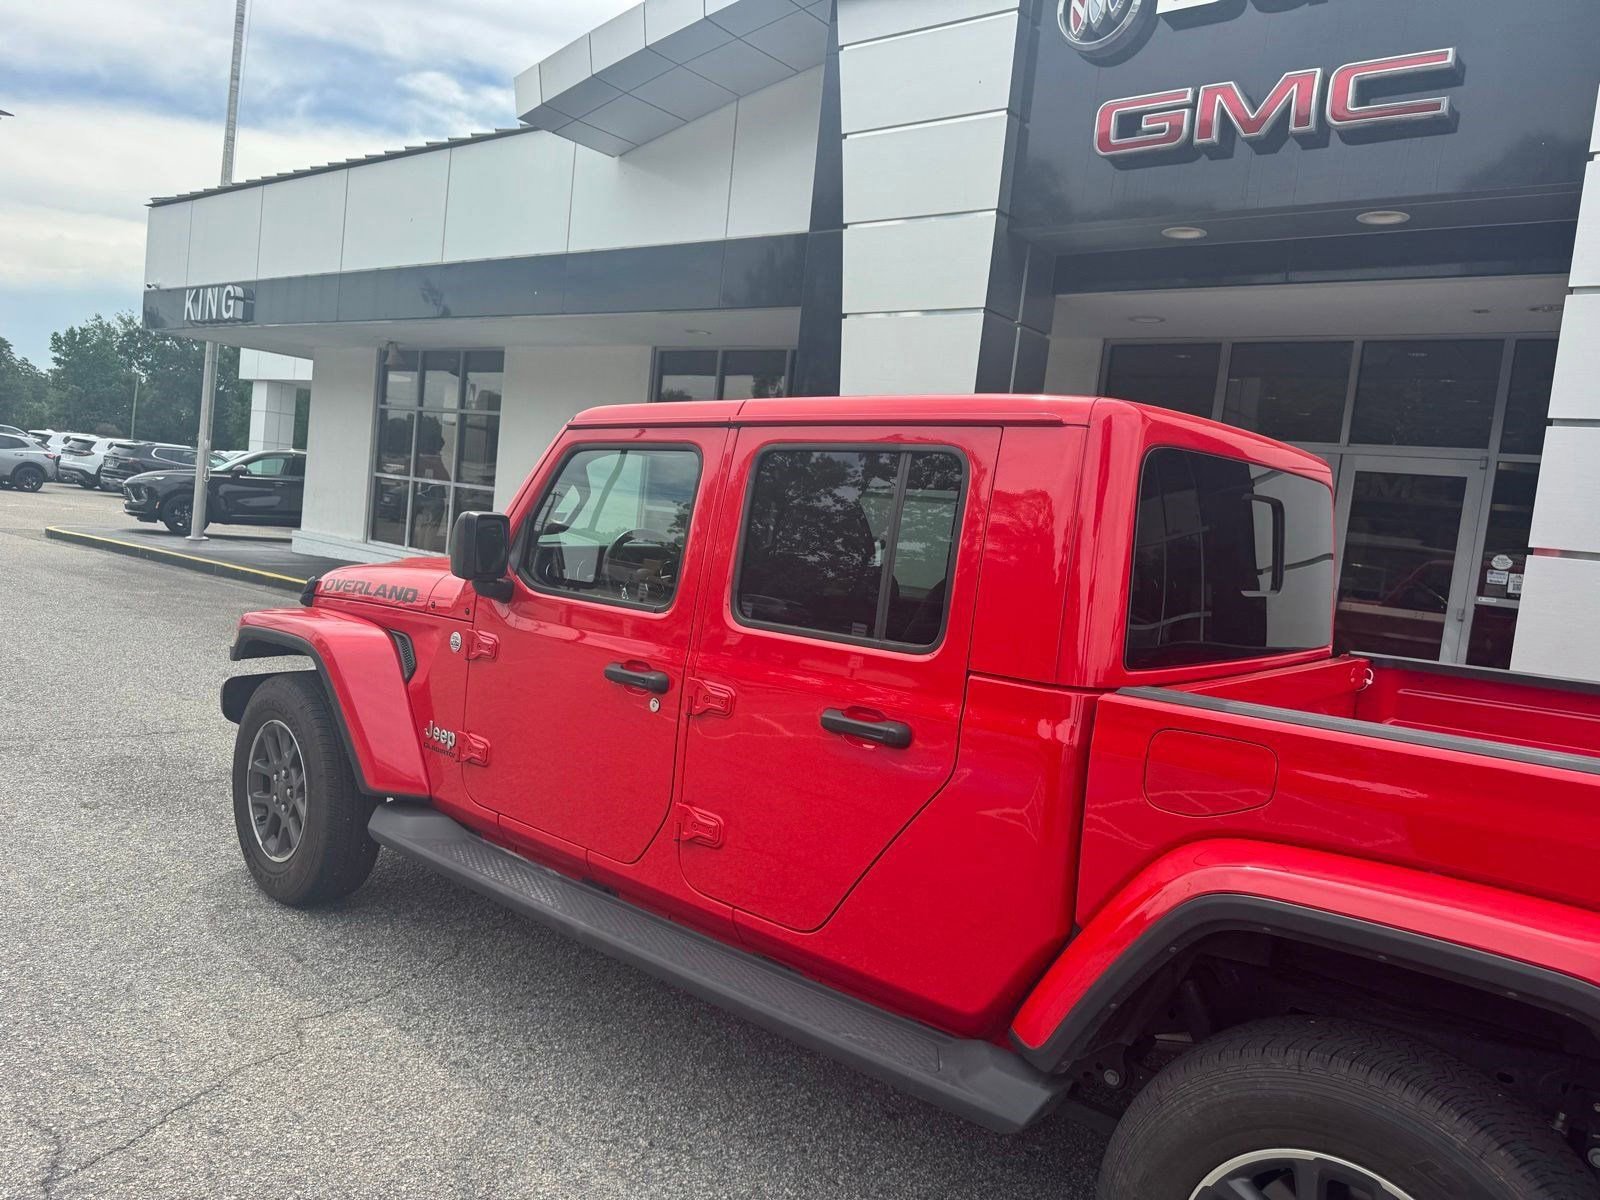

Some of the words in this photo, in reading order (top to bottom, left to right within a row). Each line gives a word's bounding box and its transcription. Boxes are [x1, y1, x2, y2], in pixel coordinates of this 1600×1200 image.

[1093, 47, 1457, 157] GMC
[184, 285, 240, 320] KING
[323, 578, 419, 604] OVERLAND
[424, 720, 456, 750] Jeep
